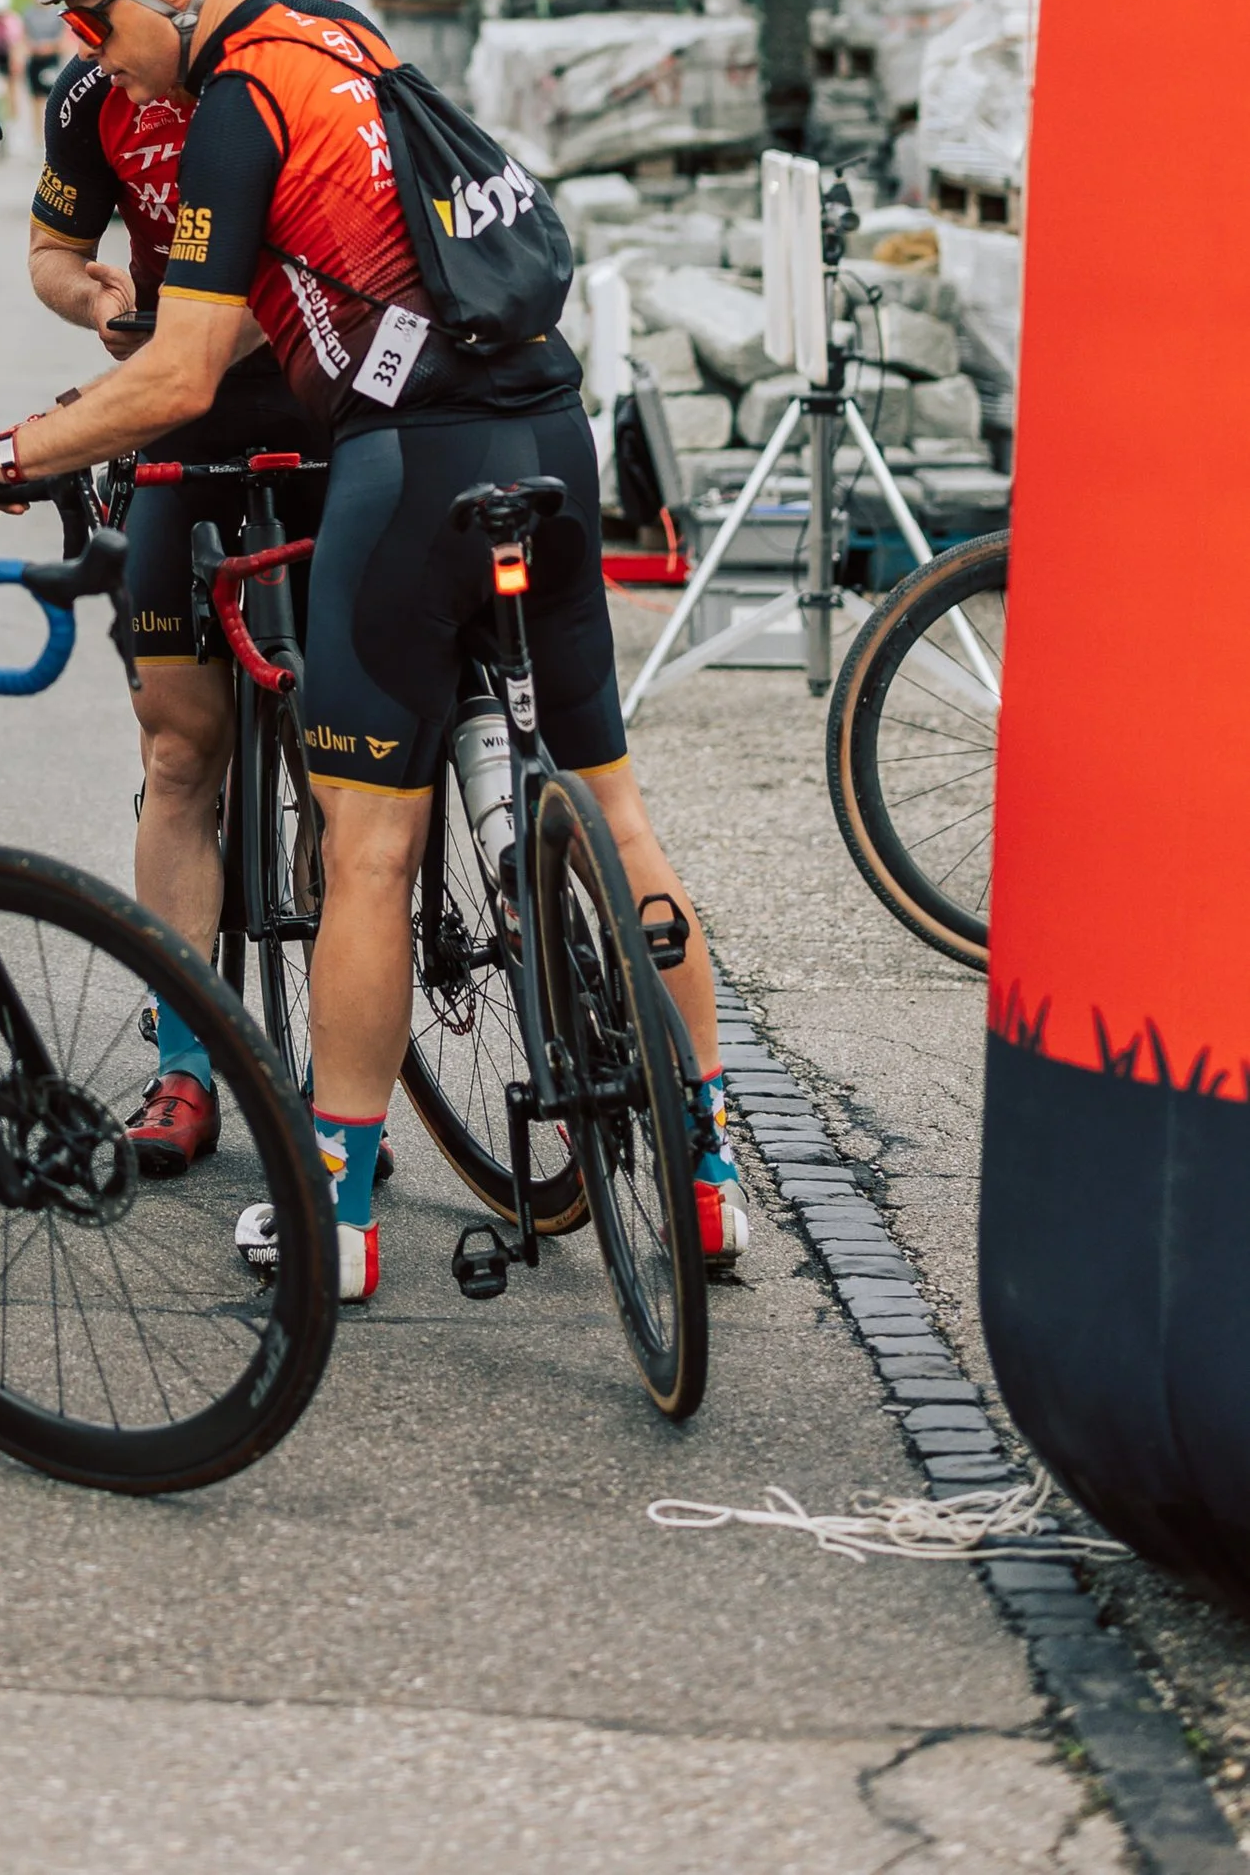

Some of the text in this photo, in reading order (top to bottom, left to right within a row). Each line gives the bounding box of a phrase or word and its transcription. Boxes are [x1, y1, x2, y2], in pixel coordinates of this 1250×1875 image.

[69, 65, 107, 103] GIR
[373, 349, 402, 388] 333
[295, 461, 328, 470] ision
